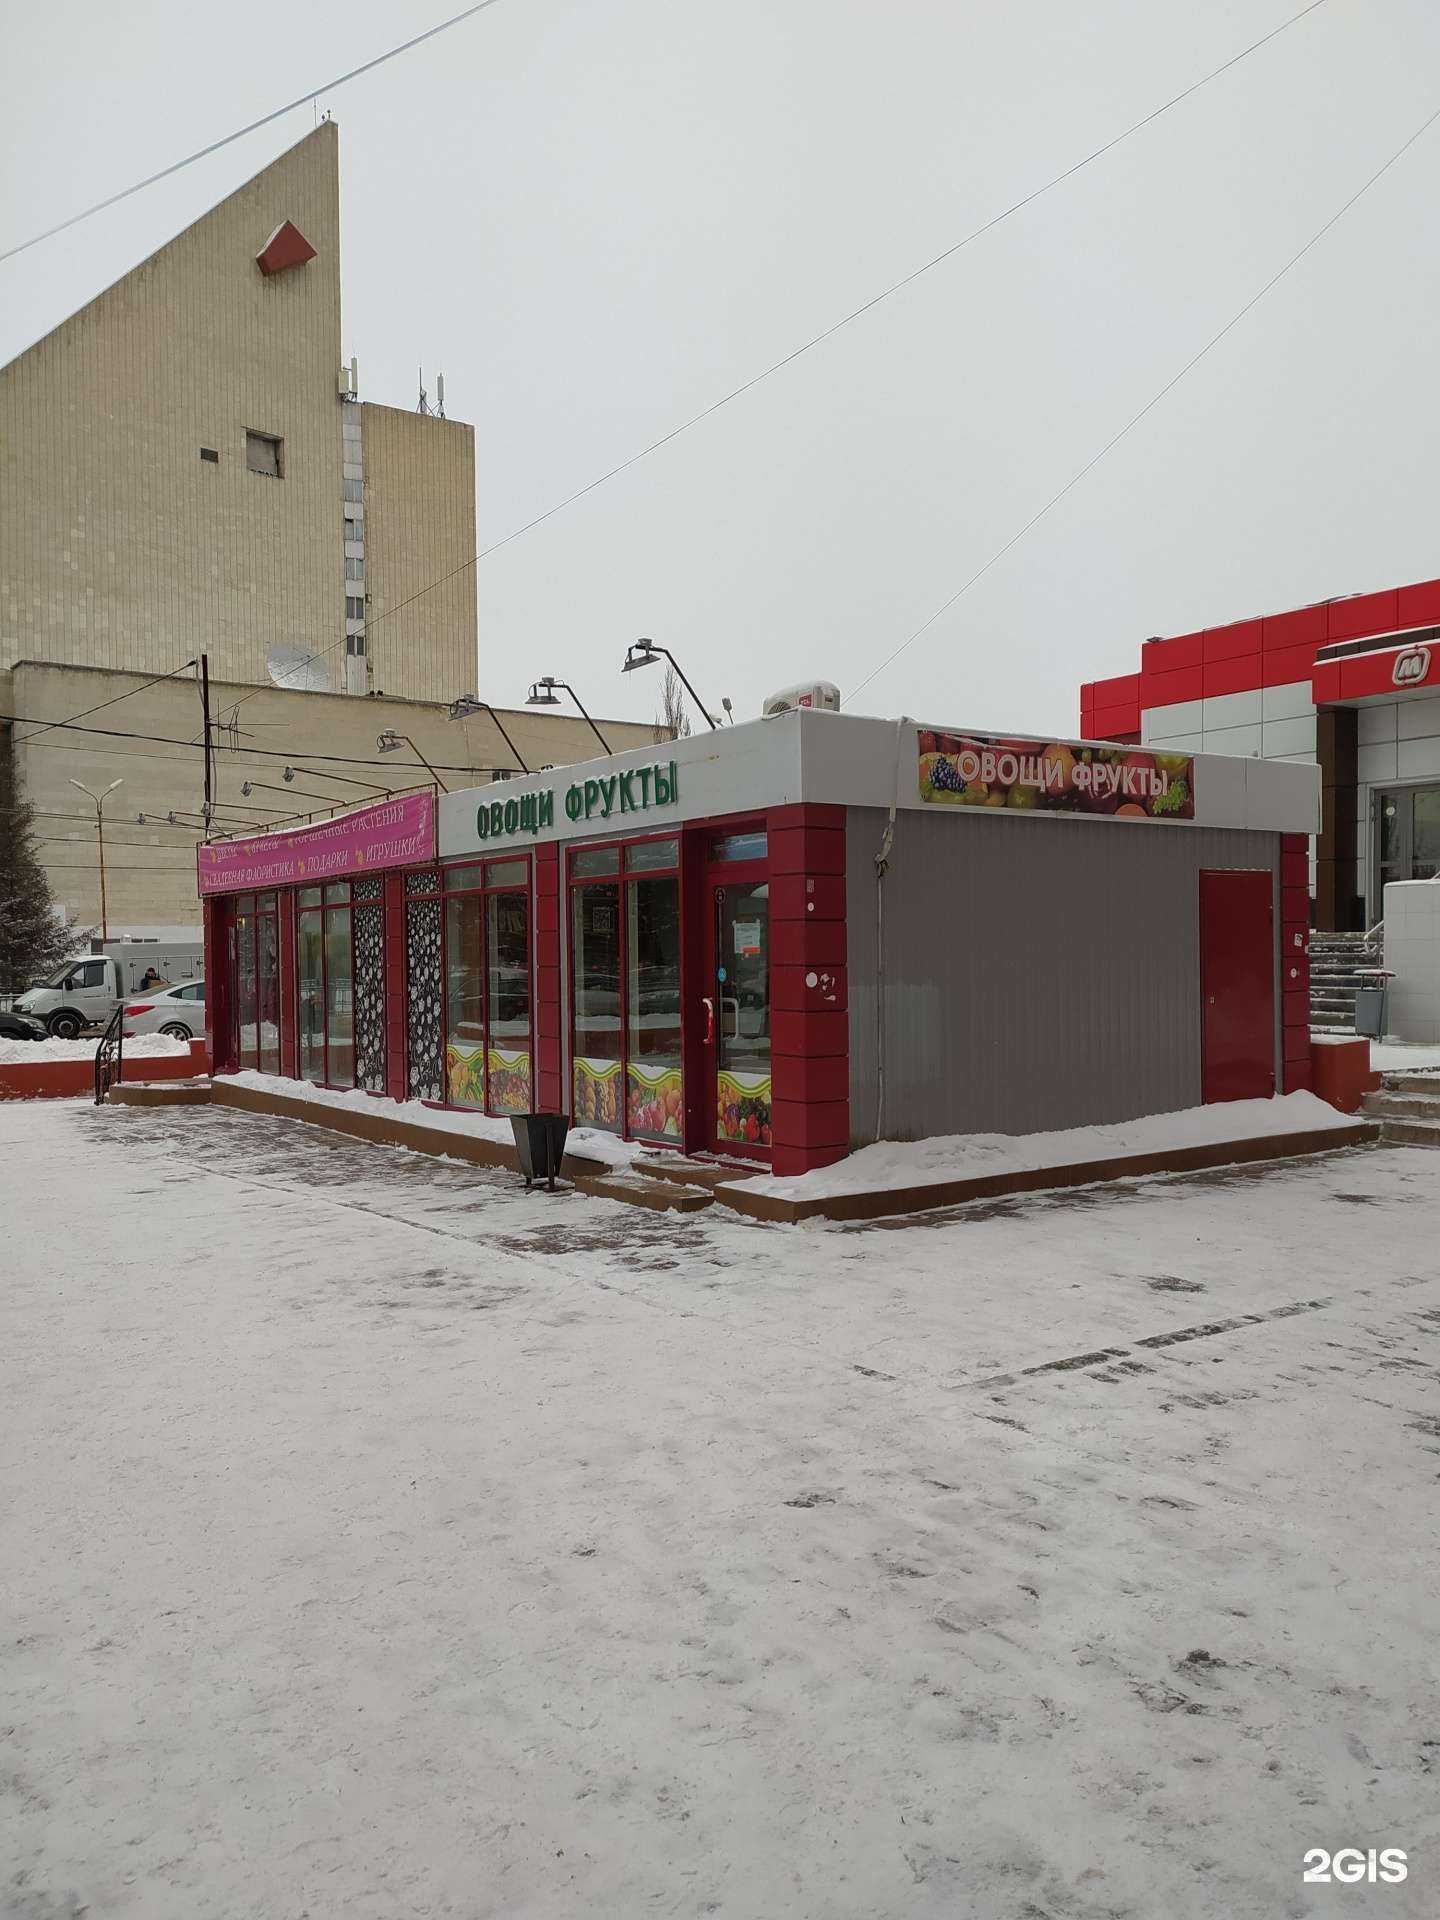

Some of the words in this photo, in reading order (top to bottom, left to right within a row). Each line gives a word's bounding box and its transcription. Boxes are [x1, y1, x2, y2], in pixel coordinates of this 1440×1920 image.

[957, 750, 1064, 794] ОВОЩИ
[1071, 762, 1169, 798] ФРУКТЫ
[351, 804, 405, 833] РАСТЕНИЯ
[476, 789, 554, 840] ОВОЩИ
[564, 761, 678, 822] ФРУКТЫ
[246, 860, 294, 882] ФЛОРИСТИКА
[306, 850, 349, 873] ПОДАРКИ
[366, 836, 417, 863] ИГРУШКИ
